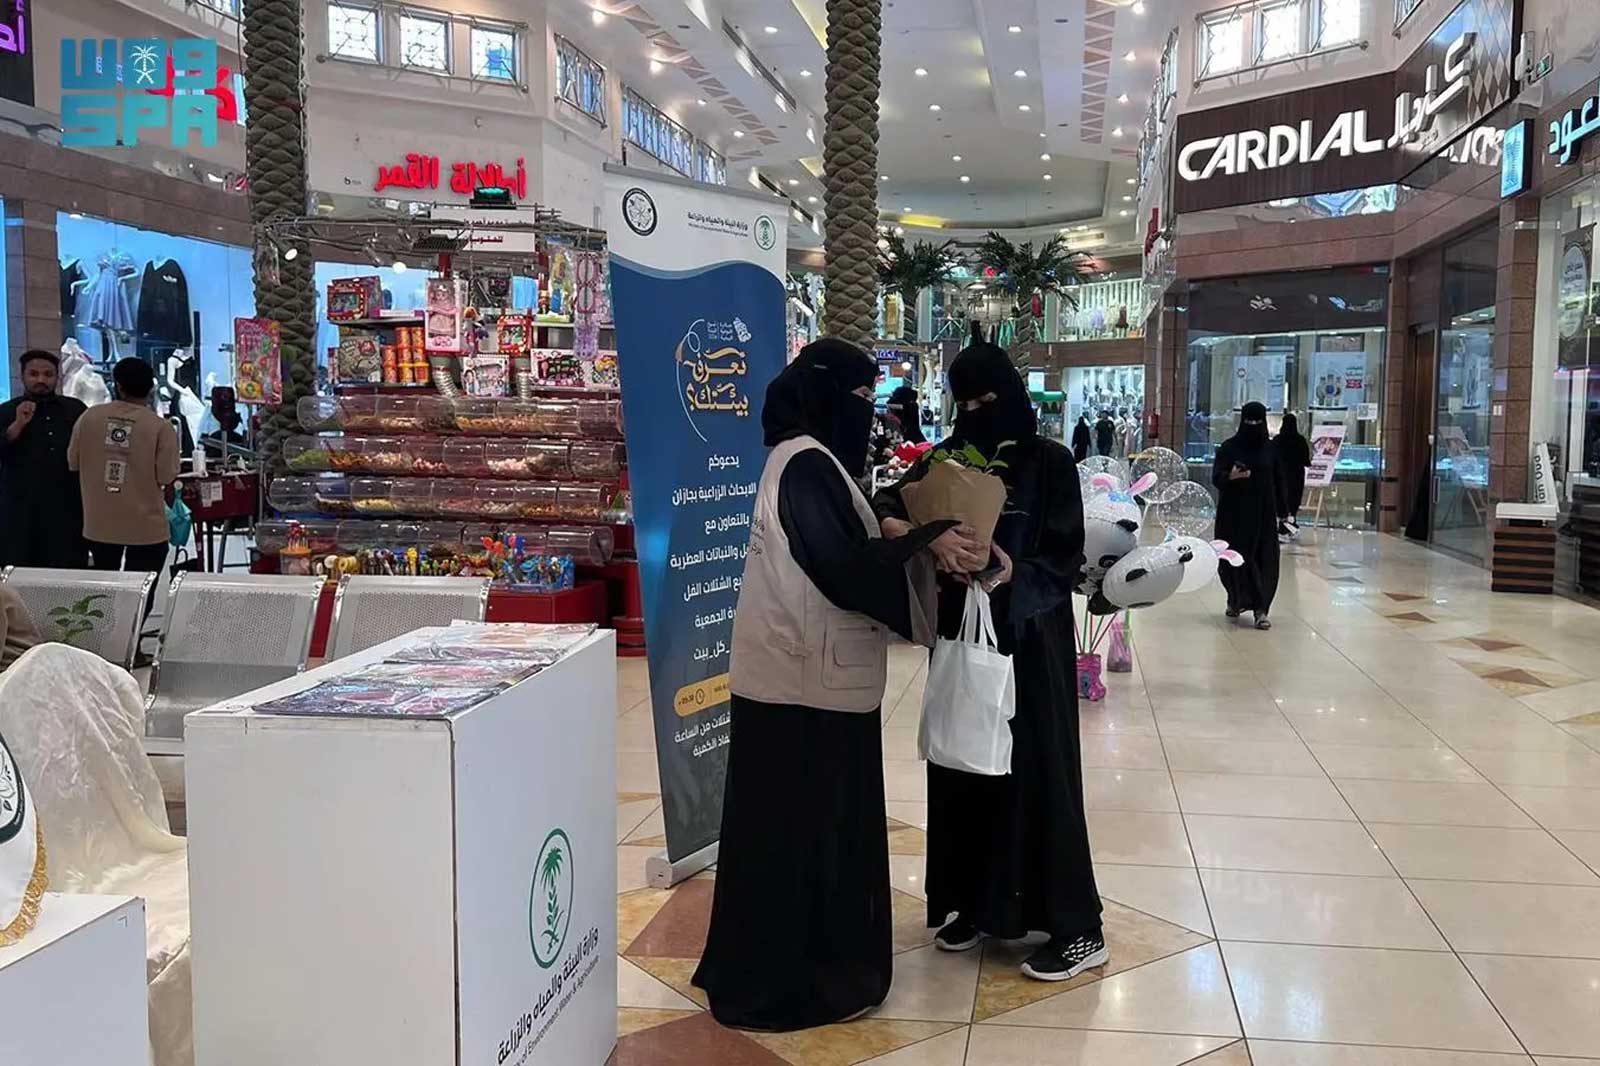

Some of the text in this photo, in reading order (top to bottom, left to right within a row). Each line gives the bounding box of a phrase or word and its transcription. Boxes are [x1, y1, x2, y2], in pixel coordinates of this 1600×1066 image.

[1549, 88, 1600, 165] عود
[1178, 110, 1386, 181] CARDIAL
[374, 152, 440, 191] القمر
[708, 454, 740, 471] يدعوكم
[672, 488, 698, 505] بجازان
[698, 485, 727, 501] الزراعية
[704, 519, 717, 534] مع
[718, 513, 750, 531] بالتعاون
[670, 550, 705, 570] العطرية
[705, 545, 739, 561] والنباتات
[694, 608, 727, 629] الجمعية
[674, 725, 699, 743] الساعة
[497, 928, 599, 1065] وزارة البيئة والمياه والزراعة
